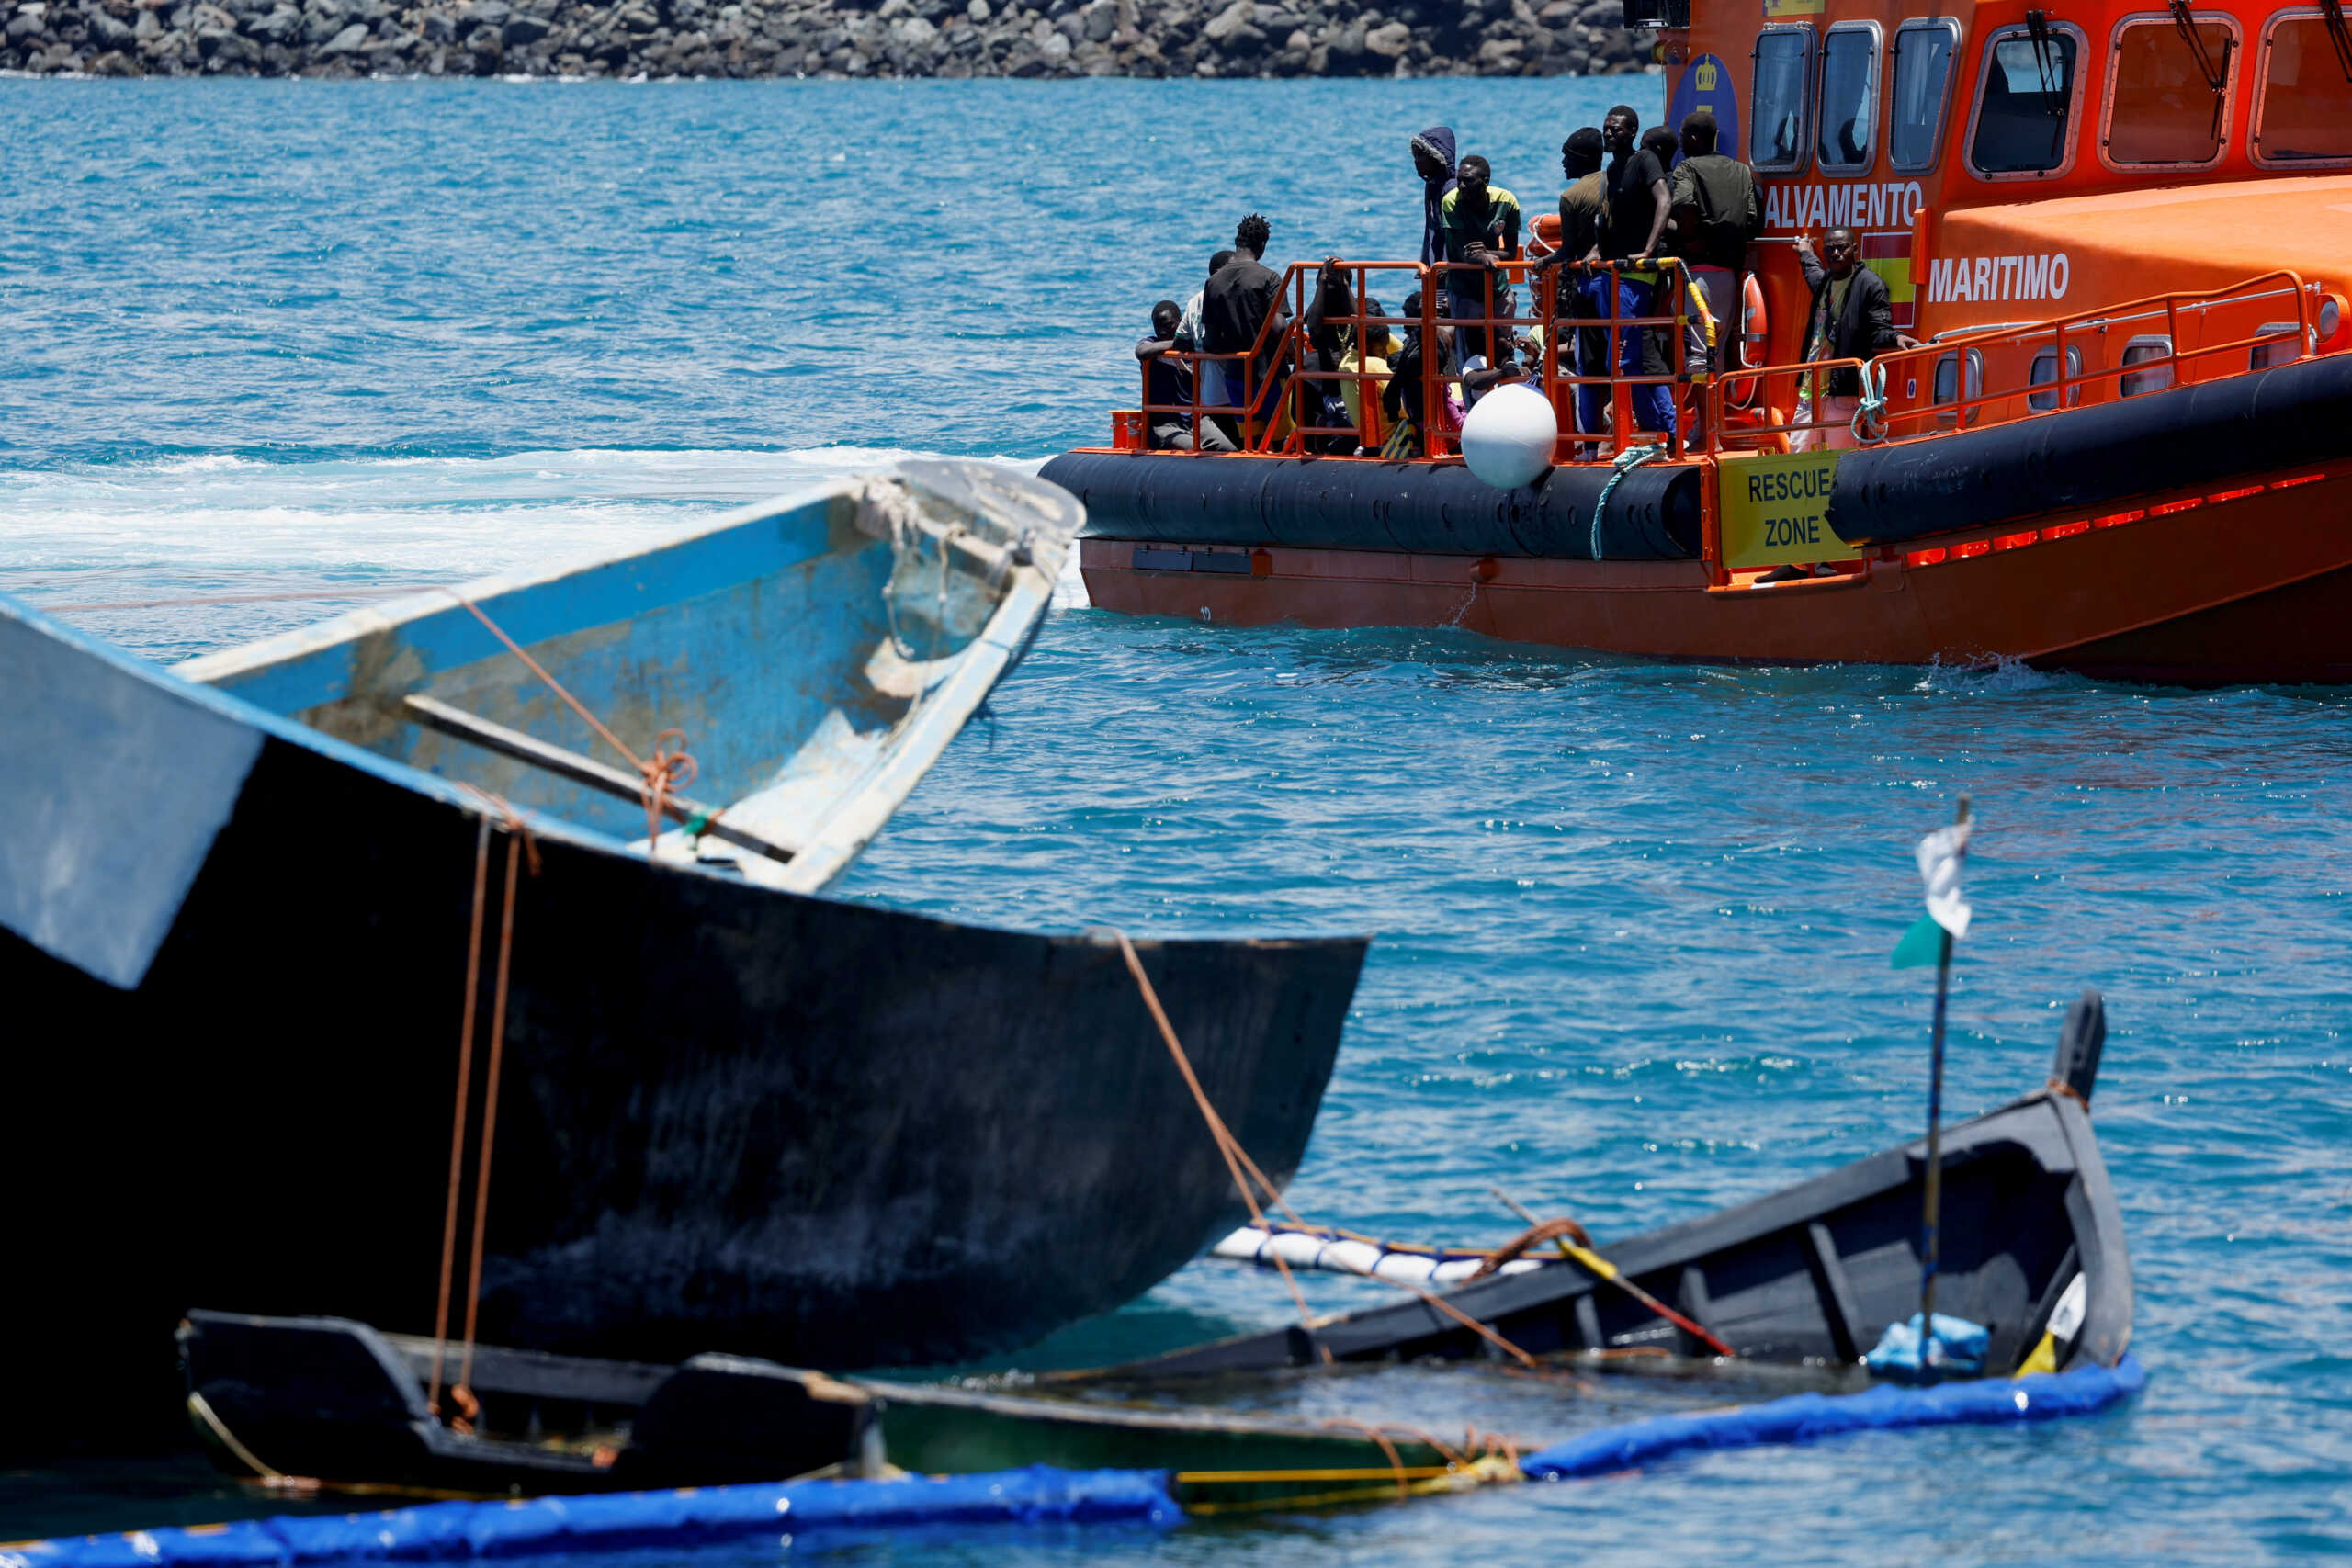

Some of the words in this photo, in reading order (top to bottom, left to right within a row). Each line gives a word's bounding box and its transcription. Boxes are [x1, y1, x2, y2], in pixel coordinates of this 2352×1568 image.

[1756, 181, 1922, 228] ALVAMENTO
[1928, 253, 2069, 302] MARITIMO
[1749, 468, 1831, 502] RESCUE
[1765, 516, 1820, 547] ZONE
